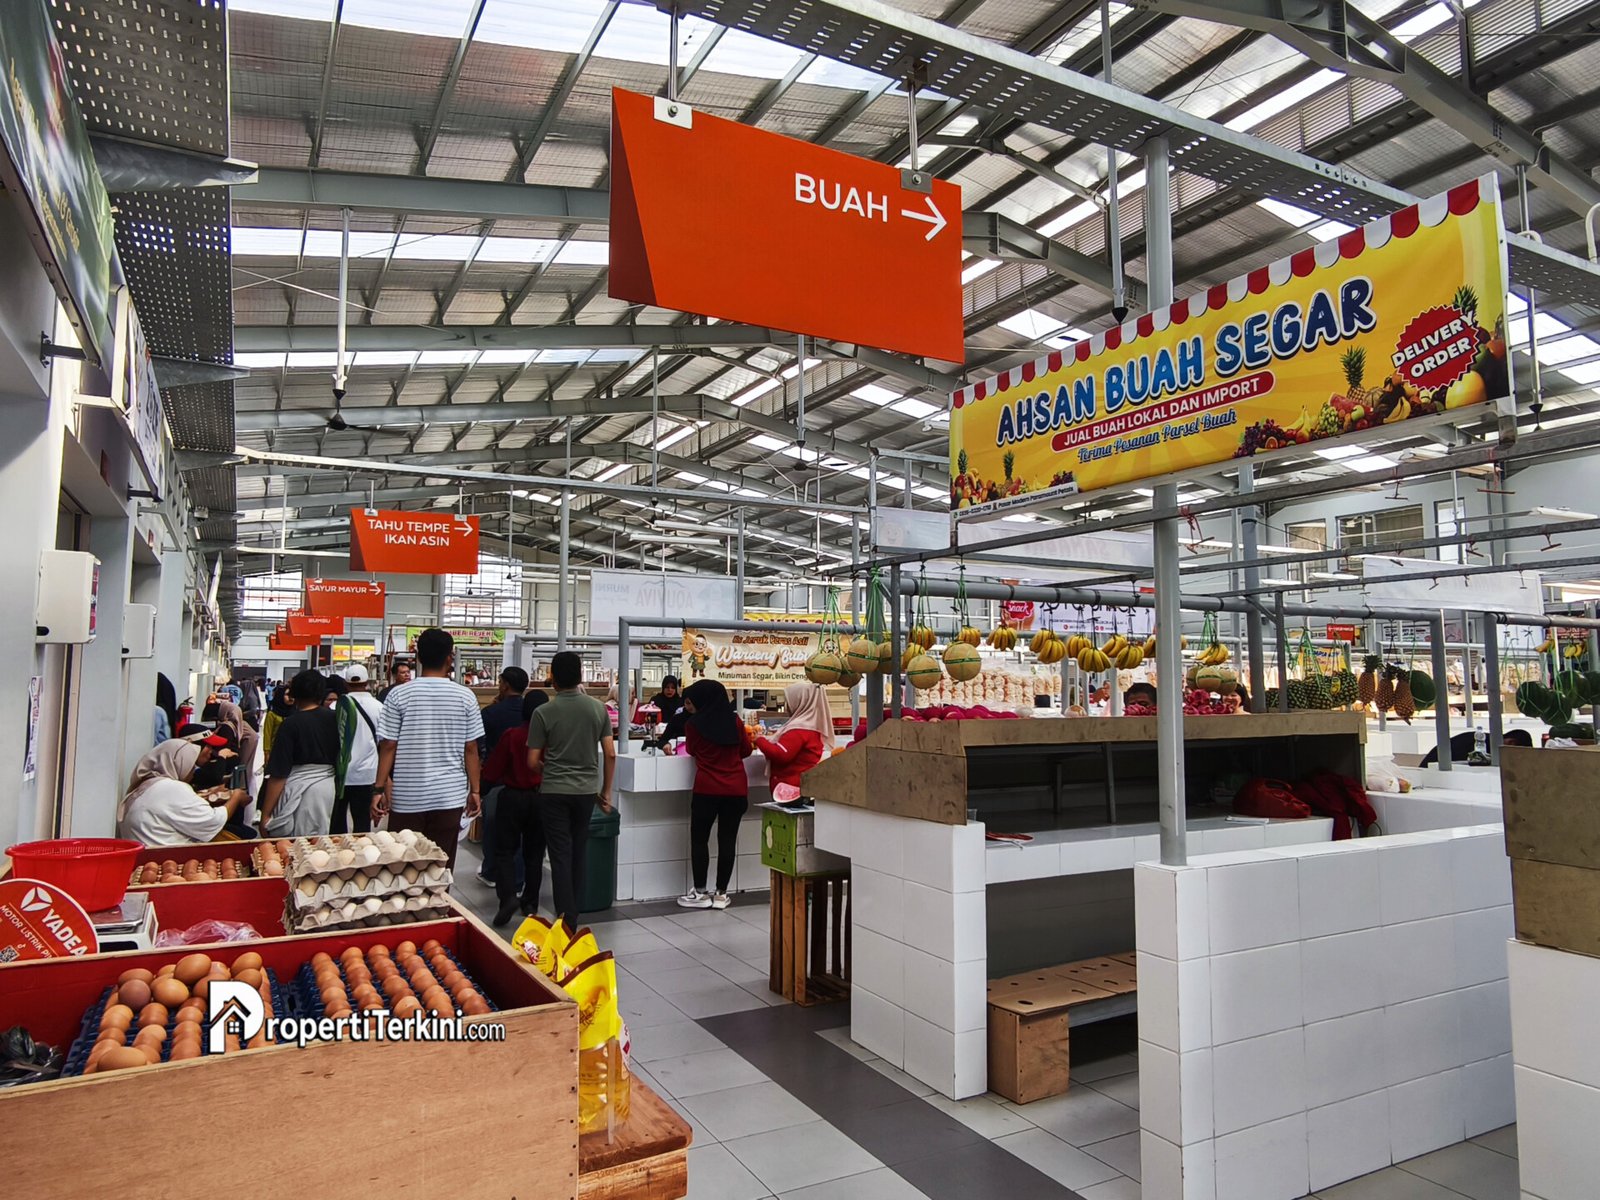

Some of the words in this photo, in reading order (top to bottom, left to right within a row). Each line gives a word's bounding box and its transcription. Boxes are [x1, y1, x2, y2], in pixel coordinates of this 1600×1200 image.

[794, 172, 888, 223] BUAH
[995, 373, 1097, 447] AHSAN
[1103, 334, 1205, 414] BUAH
[1213, 274, 1378, 378] SEGAR
[1391, 311, 1475, 369] DELIVERY
[1408, 336, 1473, 379] ORDER
[1063, 429, 1092, 447] JUAL
[1092, 419, 1126, 438] BUAH
[1127, 409, 1168, 429] LOKAL
[1169, 398, 1200, 416] DAN
[1202, 377, 1261, 407] IMPORT
[1078, 444, 1112, 464] Terima
[1114, 431, 1160, 454] Pesanan
[1161, 419, 1201, 440] Parsel
[1201, 408, 1238, 430] Buah
[367, 518, 404, 532] TAHU
[406, 521, 451, 534] TEMPE
[384, 533, 418, 545] IKAN
[419, 535, 450, 547] ASIN
[309, 585, 337, 593] SAYUR
[718, 671, 752, 680] Minuman
[0, 904, 24, 929] MOTOR
[20, 926, 45, 952] LISTRIK
[41, 908, 89, 957] YADEA
